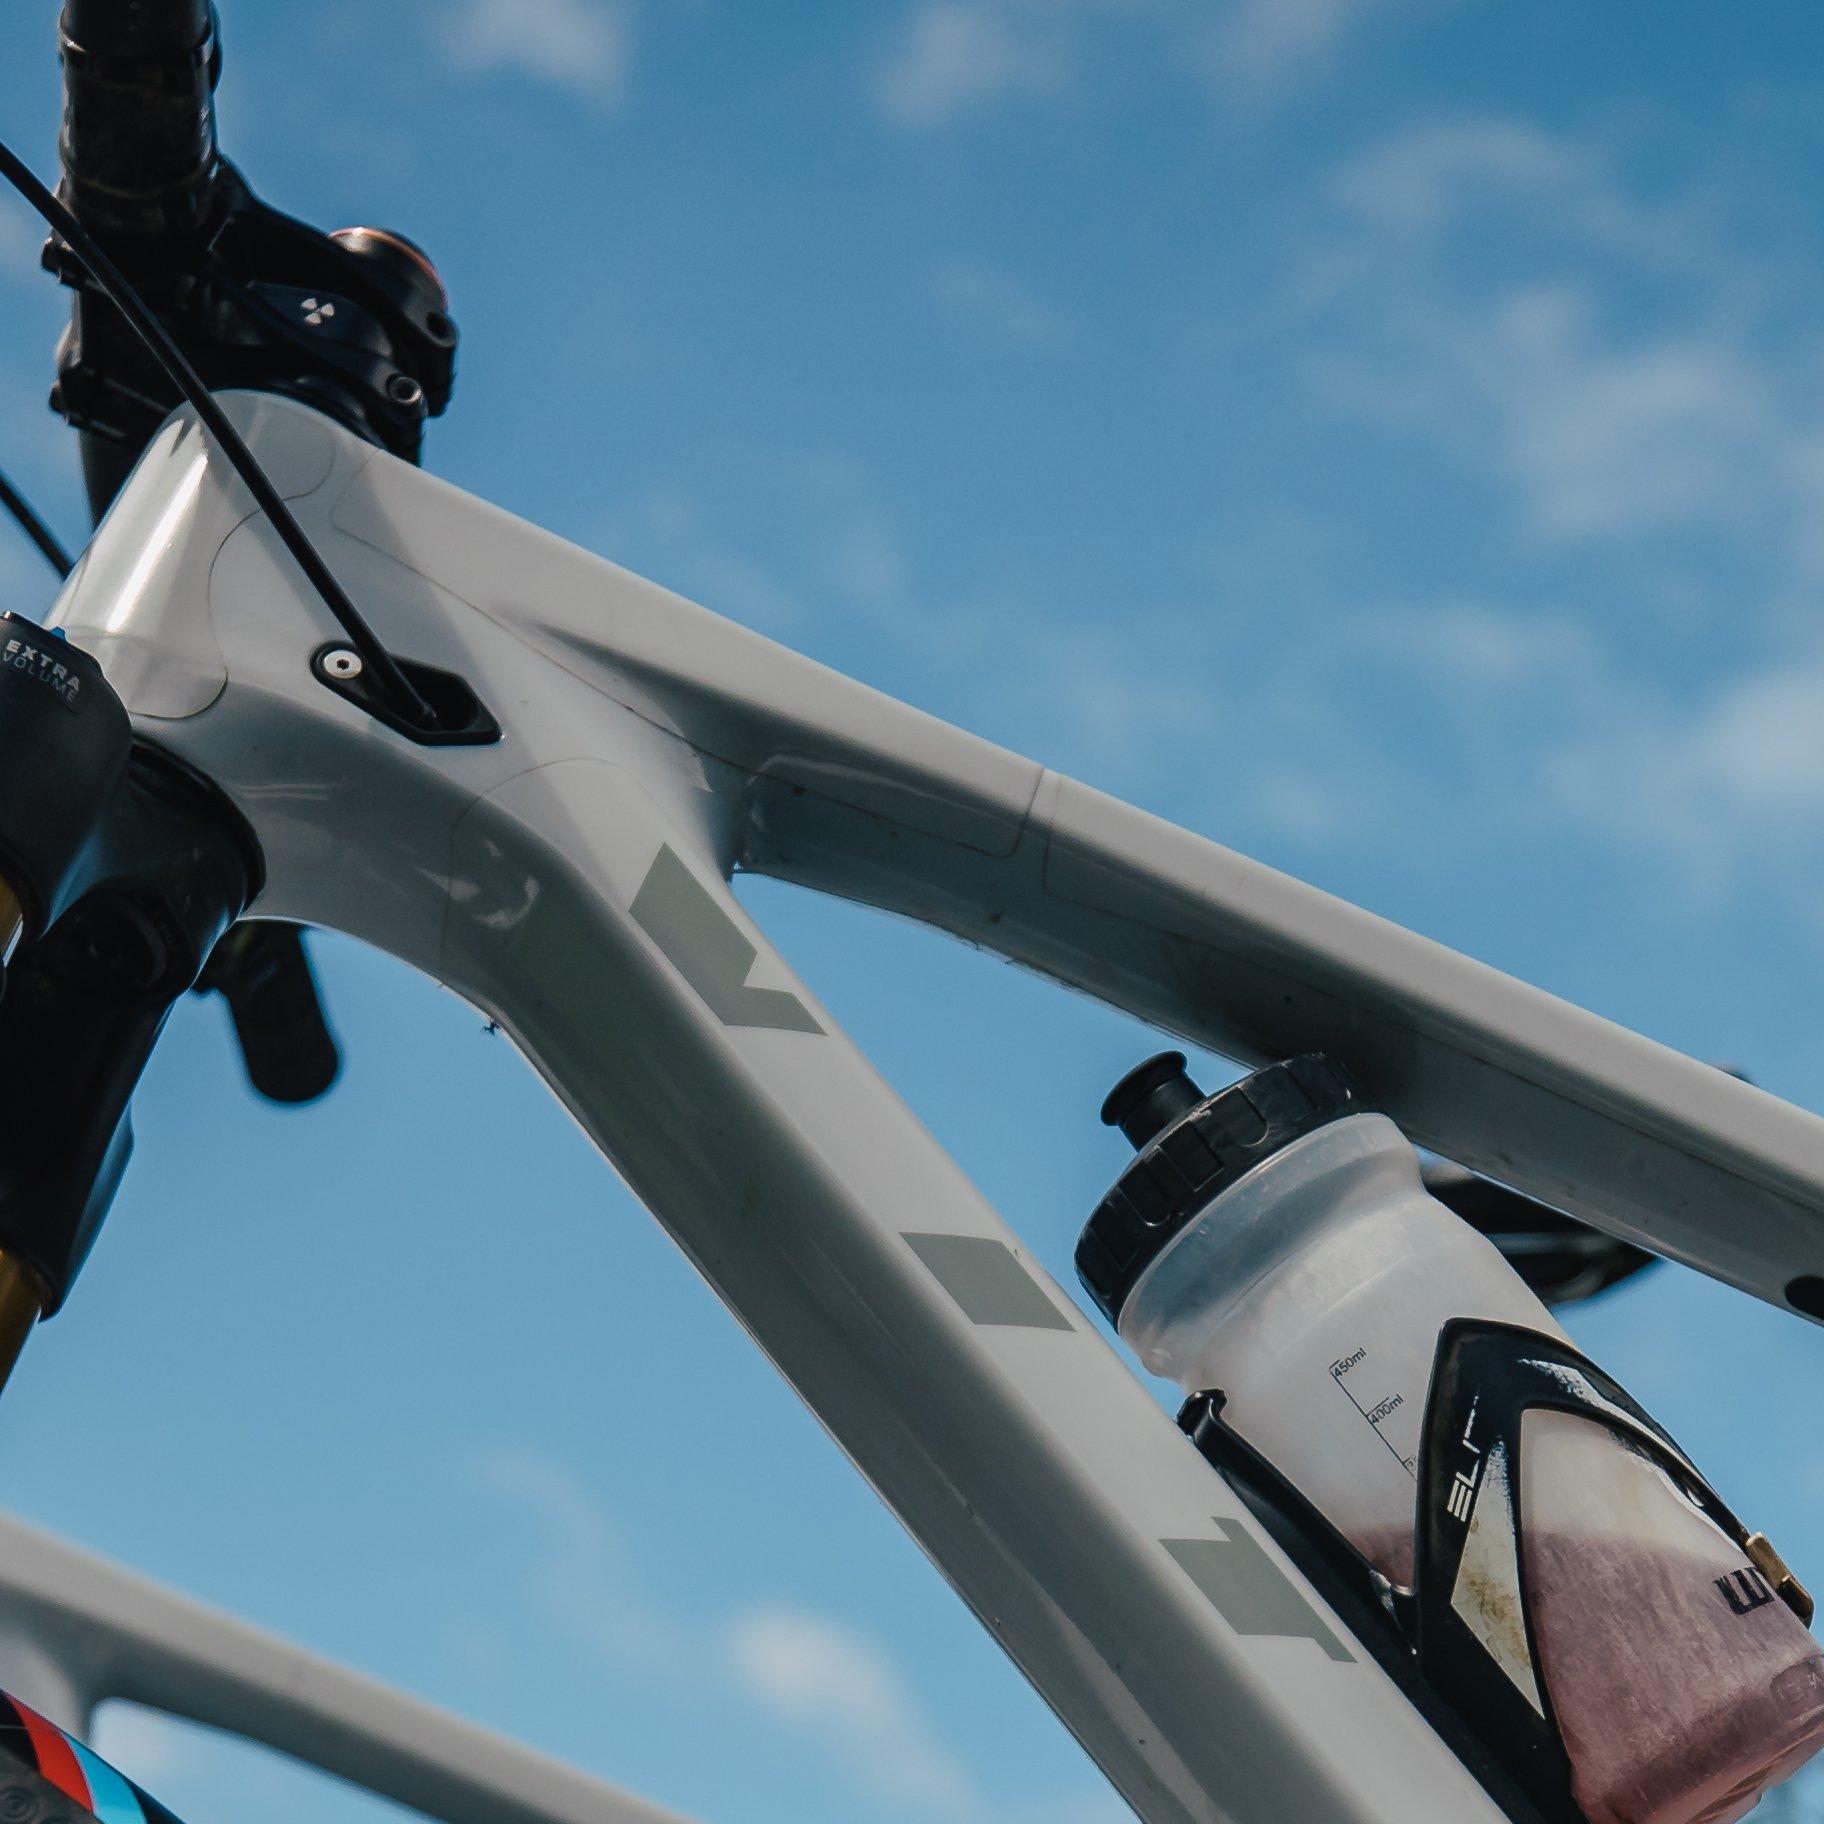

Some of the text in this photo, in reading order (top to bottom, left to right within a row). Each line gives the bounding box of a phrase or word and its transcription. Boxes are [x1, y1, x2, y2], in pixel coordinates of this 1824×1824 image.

[3, 652, 77, 702] VOLUME
[6, 638, 80, 691] EXTRA
[1333, 1346, 1367, 1378] 450ml
[1370, 1393, 1405, 1425] 400ml
